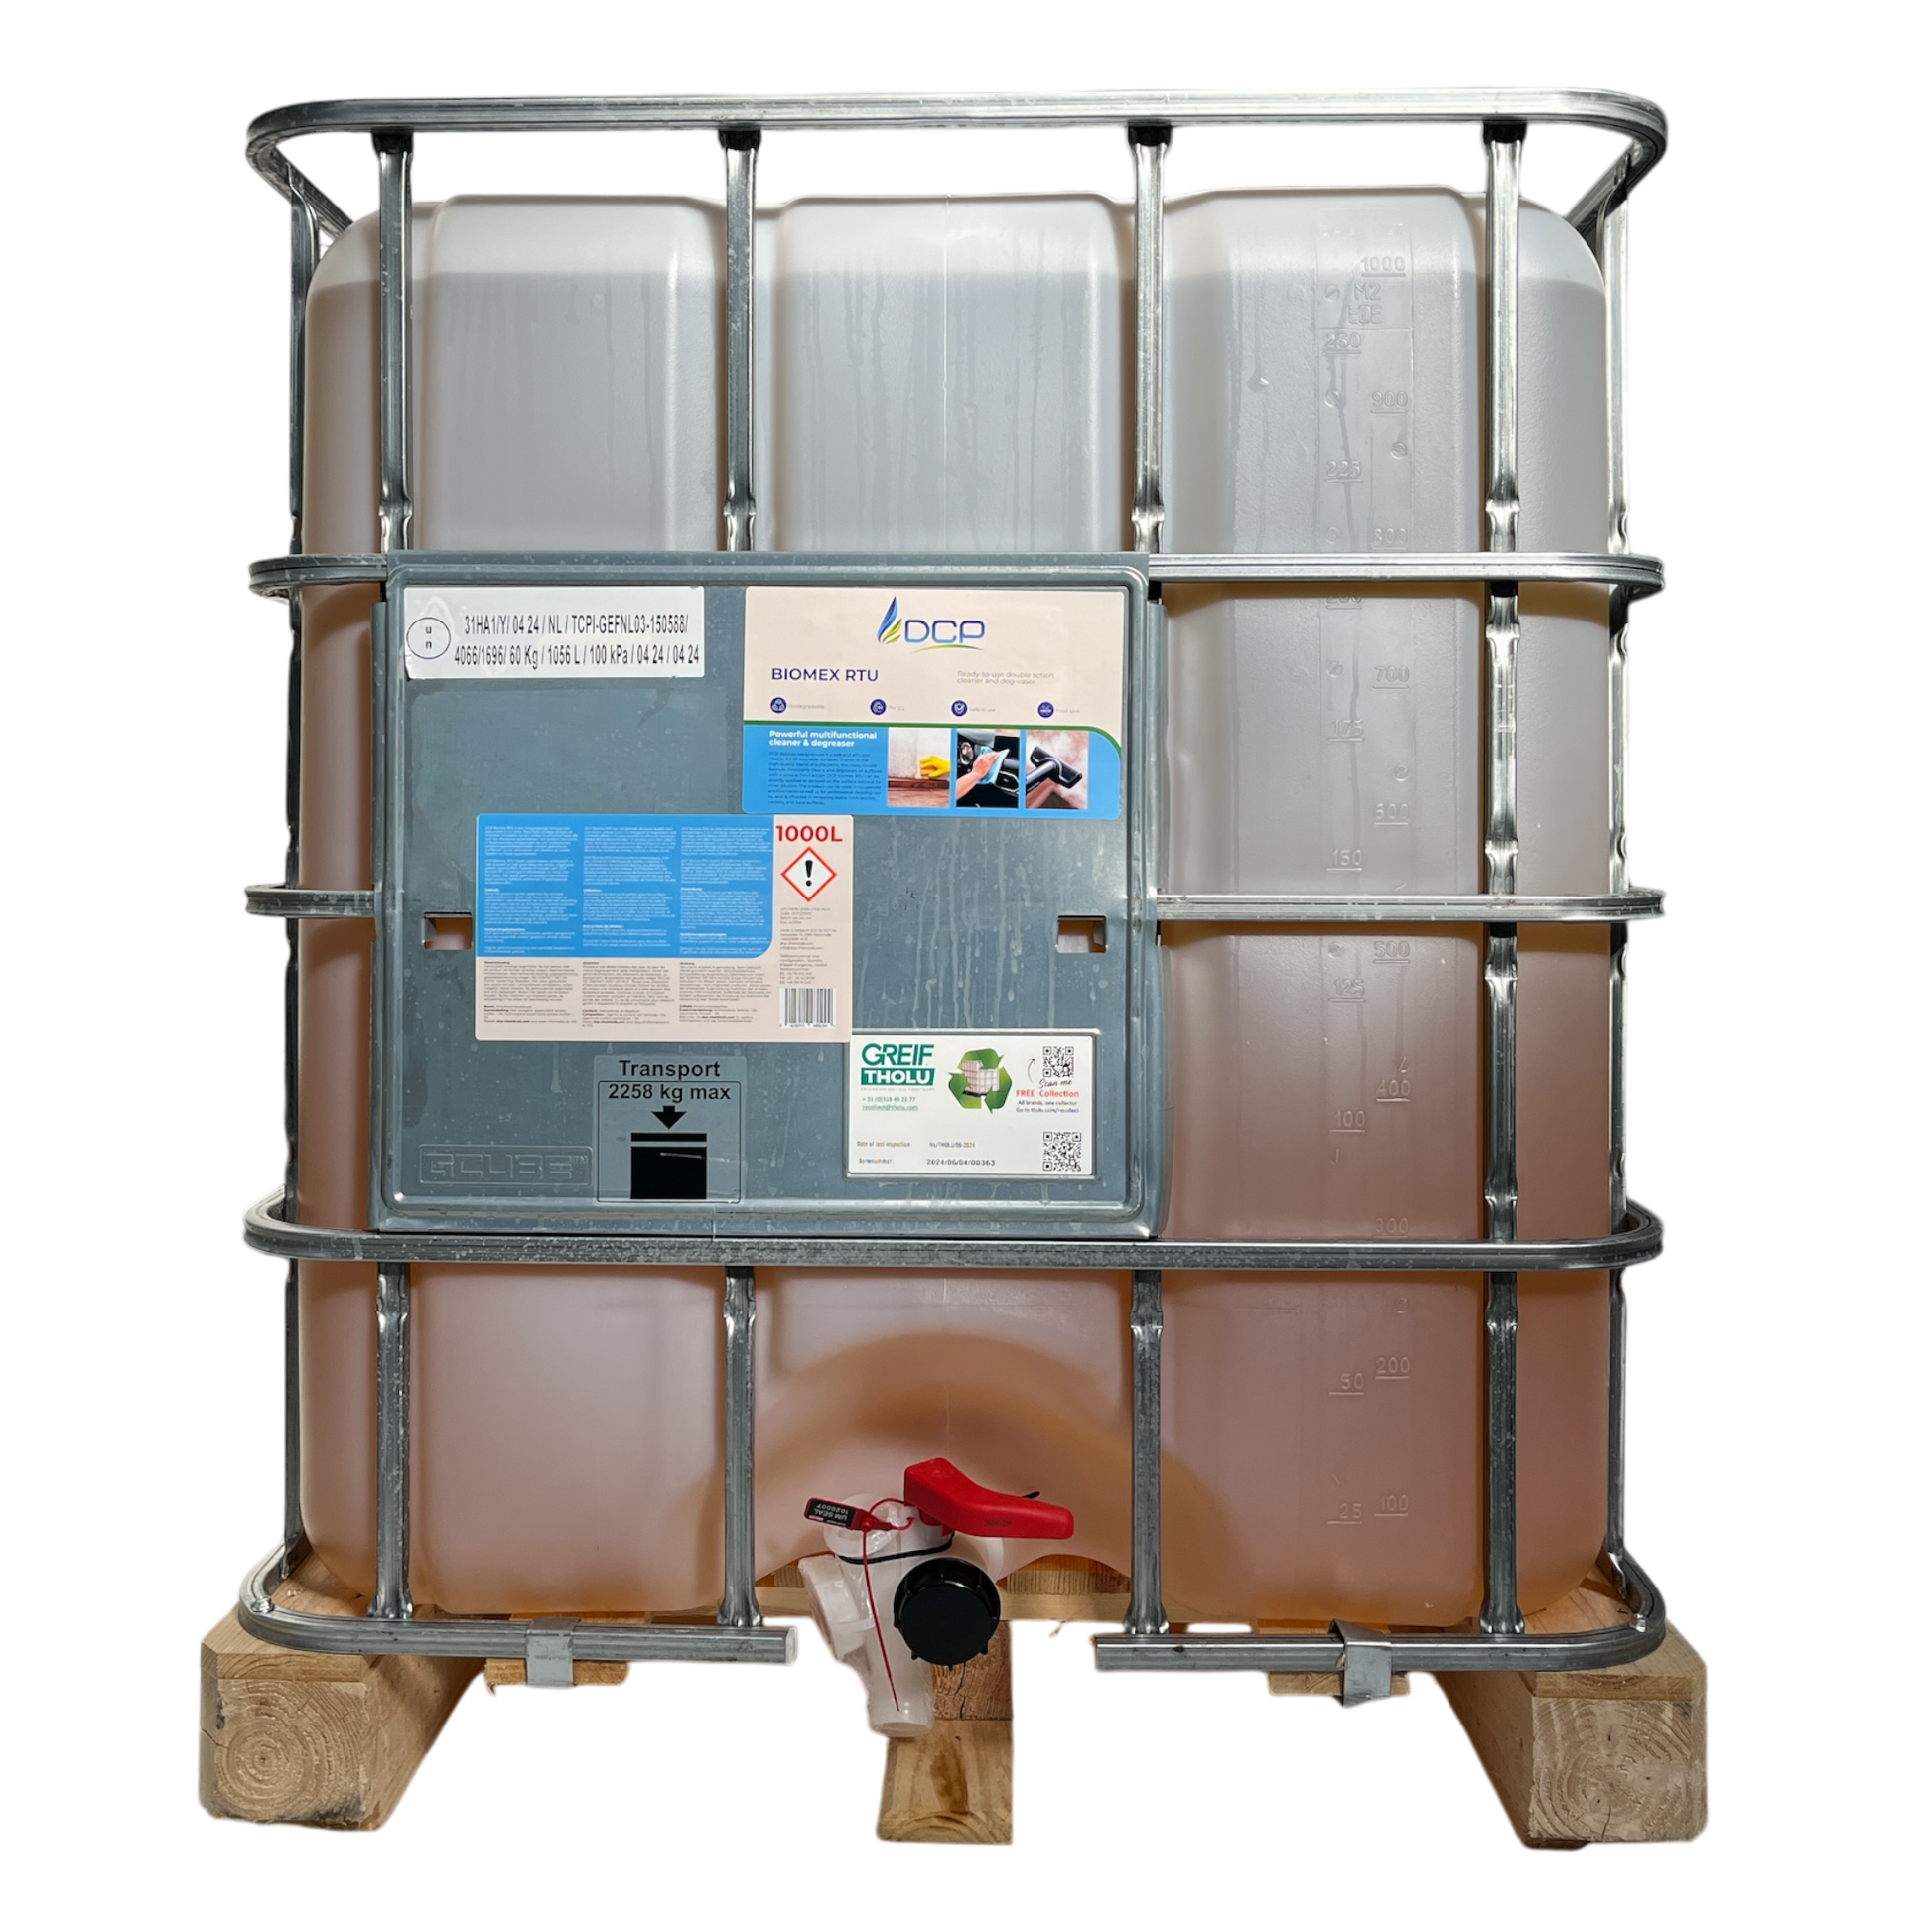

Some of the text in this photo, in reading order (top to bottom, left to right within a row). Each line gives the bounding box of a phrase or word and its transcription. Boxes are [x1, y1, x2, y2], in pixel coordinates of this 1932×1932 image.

[1361, 256, 1406, 272] 1000
[1354, 282, 1381, 301] M2
[1324, 333, 1361, 349] 250
[1371, 390, 1408, 408] 900
[1325, 460, 1363, 478] 225
[1373, 528, 1408, 545] 800
[465, 615, 510, 635] 31HA1/Y/
[512, 616, 525, 635] 04
[527, 616, 540, 635] 24
[548, 615, 562, 634] NL
[903, 619, 986, 644] DCP
[454, 645, 507, 666] 4066/1696/
[509, 646, 522, 666] 60
[524, 645, 539, 670] Kg
[548, 644, 571, 665] 1056
[574, 645, 580, 665] L
[590, 645, 607, 664] 100
[610, 644, 628, 665] kPa
[637, 645, 649, 664] 04
[652, 645, 664, 664] 24
[672, 645, 685, 664] 04
[688, 645, 700, 665] 24
[771, 667, 880, 683] BIOMEX RTU
[1374, 666, 1410, 684] 700
[810, 731, 877, 739] multifunctional
[1331, 719, 1364, 737] 175
[811, 739, 855, 748] degreaser
[1374, 803, 1410, 820] 600
[775, 825, 844, 843] 1000L
[1331, 849, 1363, 867] 150
[1373, 941, 1410, 958] 500
[1332, 978, 1365, 997] 125
[861, 1042, 935, 1066] GREIF
[618, 1059, 721, 1081] Transport
[864, 1069, 931, 1085] THOLU
[1039, 1078, 1058, 1089] Scan
[1376, 1079, 1411, 1097] 400
[608, 1083, 731, 1103] 2258 kg max
[1334, 1110, 1366, 1128] 100
[1374, 1217, 1409, 1235] 300
[1375, 1357, 1410, 1374] 200
[1340, 1373, 1364, 1390] 50
[1338, 1503, 1363, 1520] 25
[1378, 1495, 1409, 1512] 100
